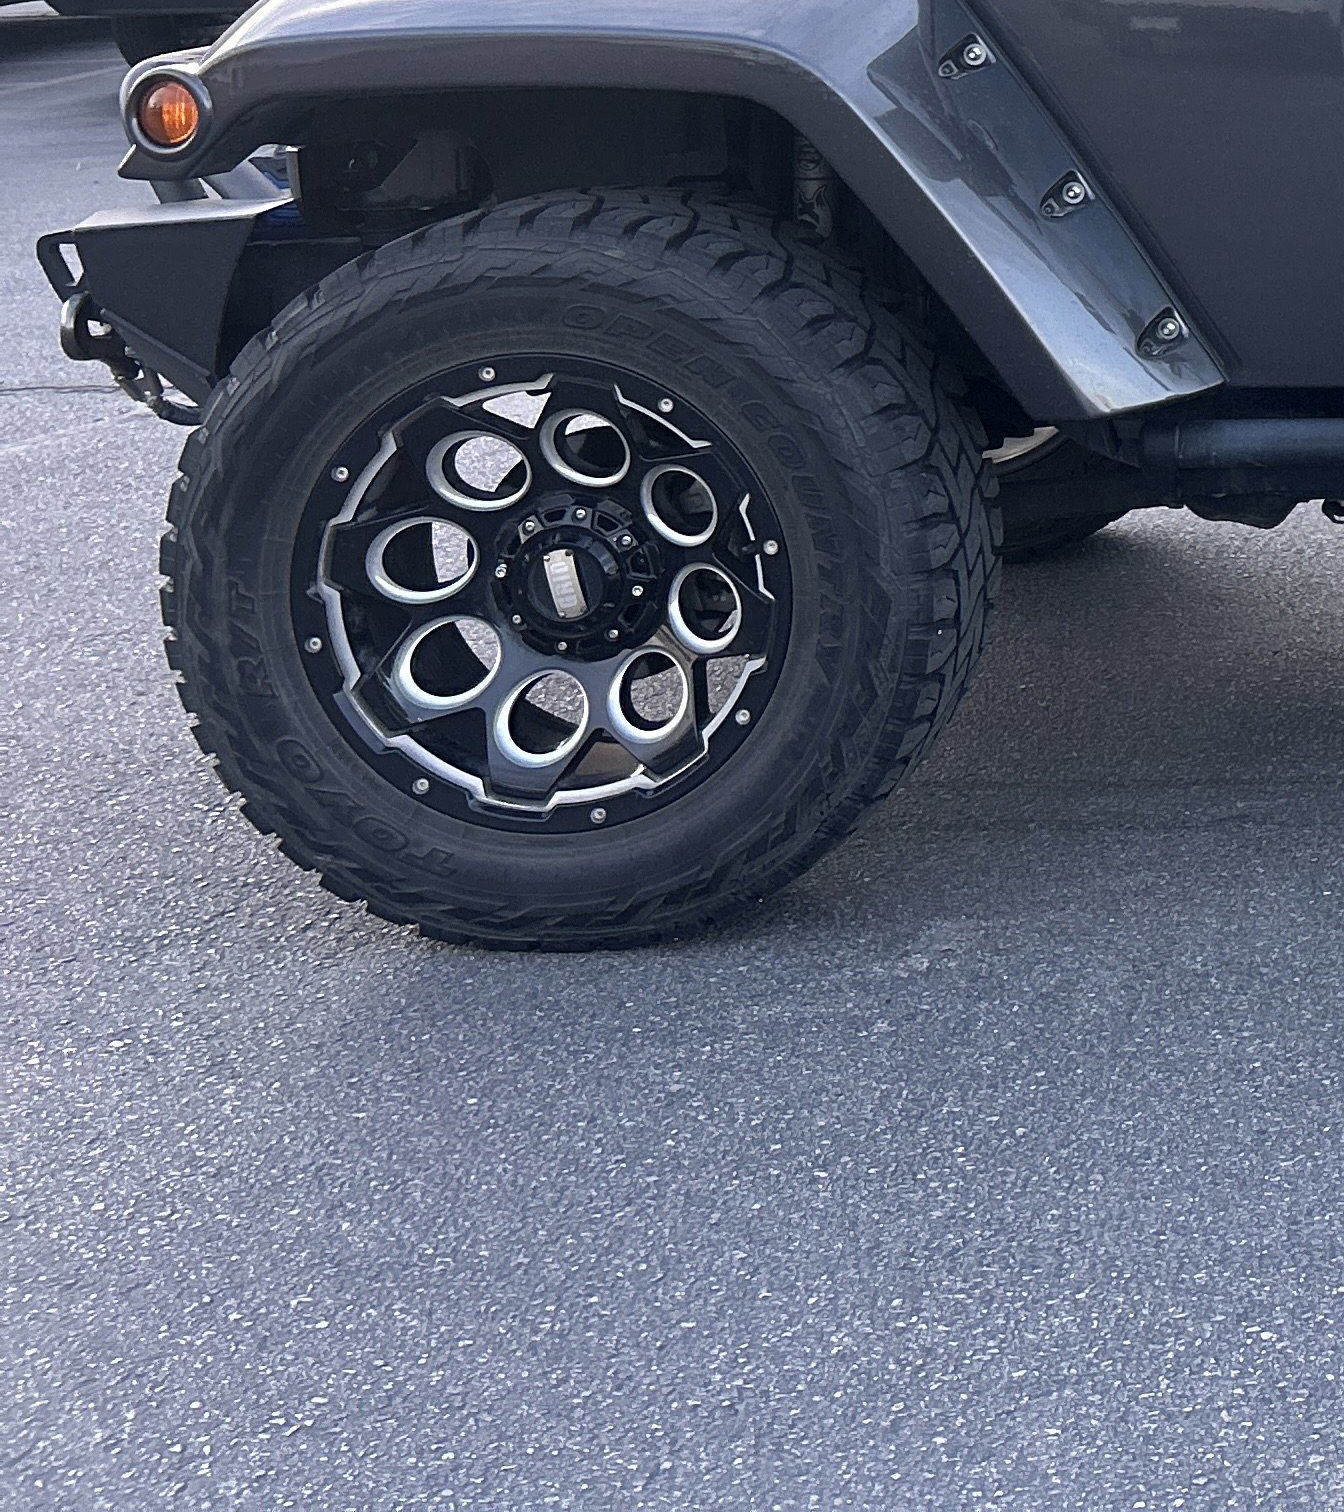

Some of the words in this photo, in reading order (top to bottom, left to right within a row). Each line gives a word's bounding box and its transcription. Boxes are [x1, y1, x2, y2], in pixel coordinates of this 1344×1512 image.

[550, 561, 578, 609] GRID
[562, 305, 739, 389] OPEN
[742, 400, 847, 686] COUNTRY
